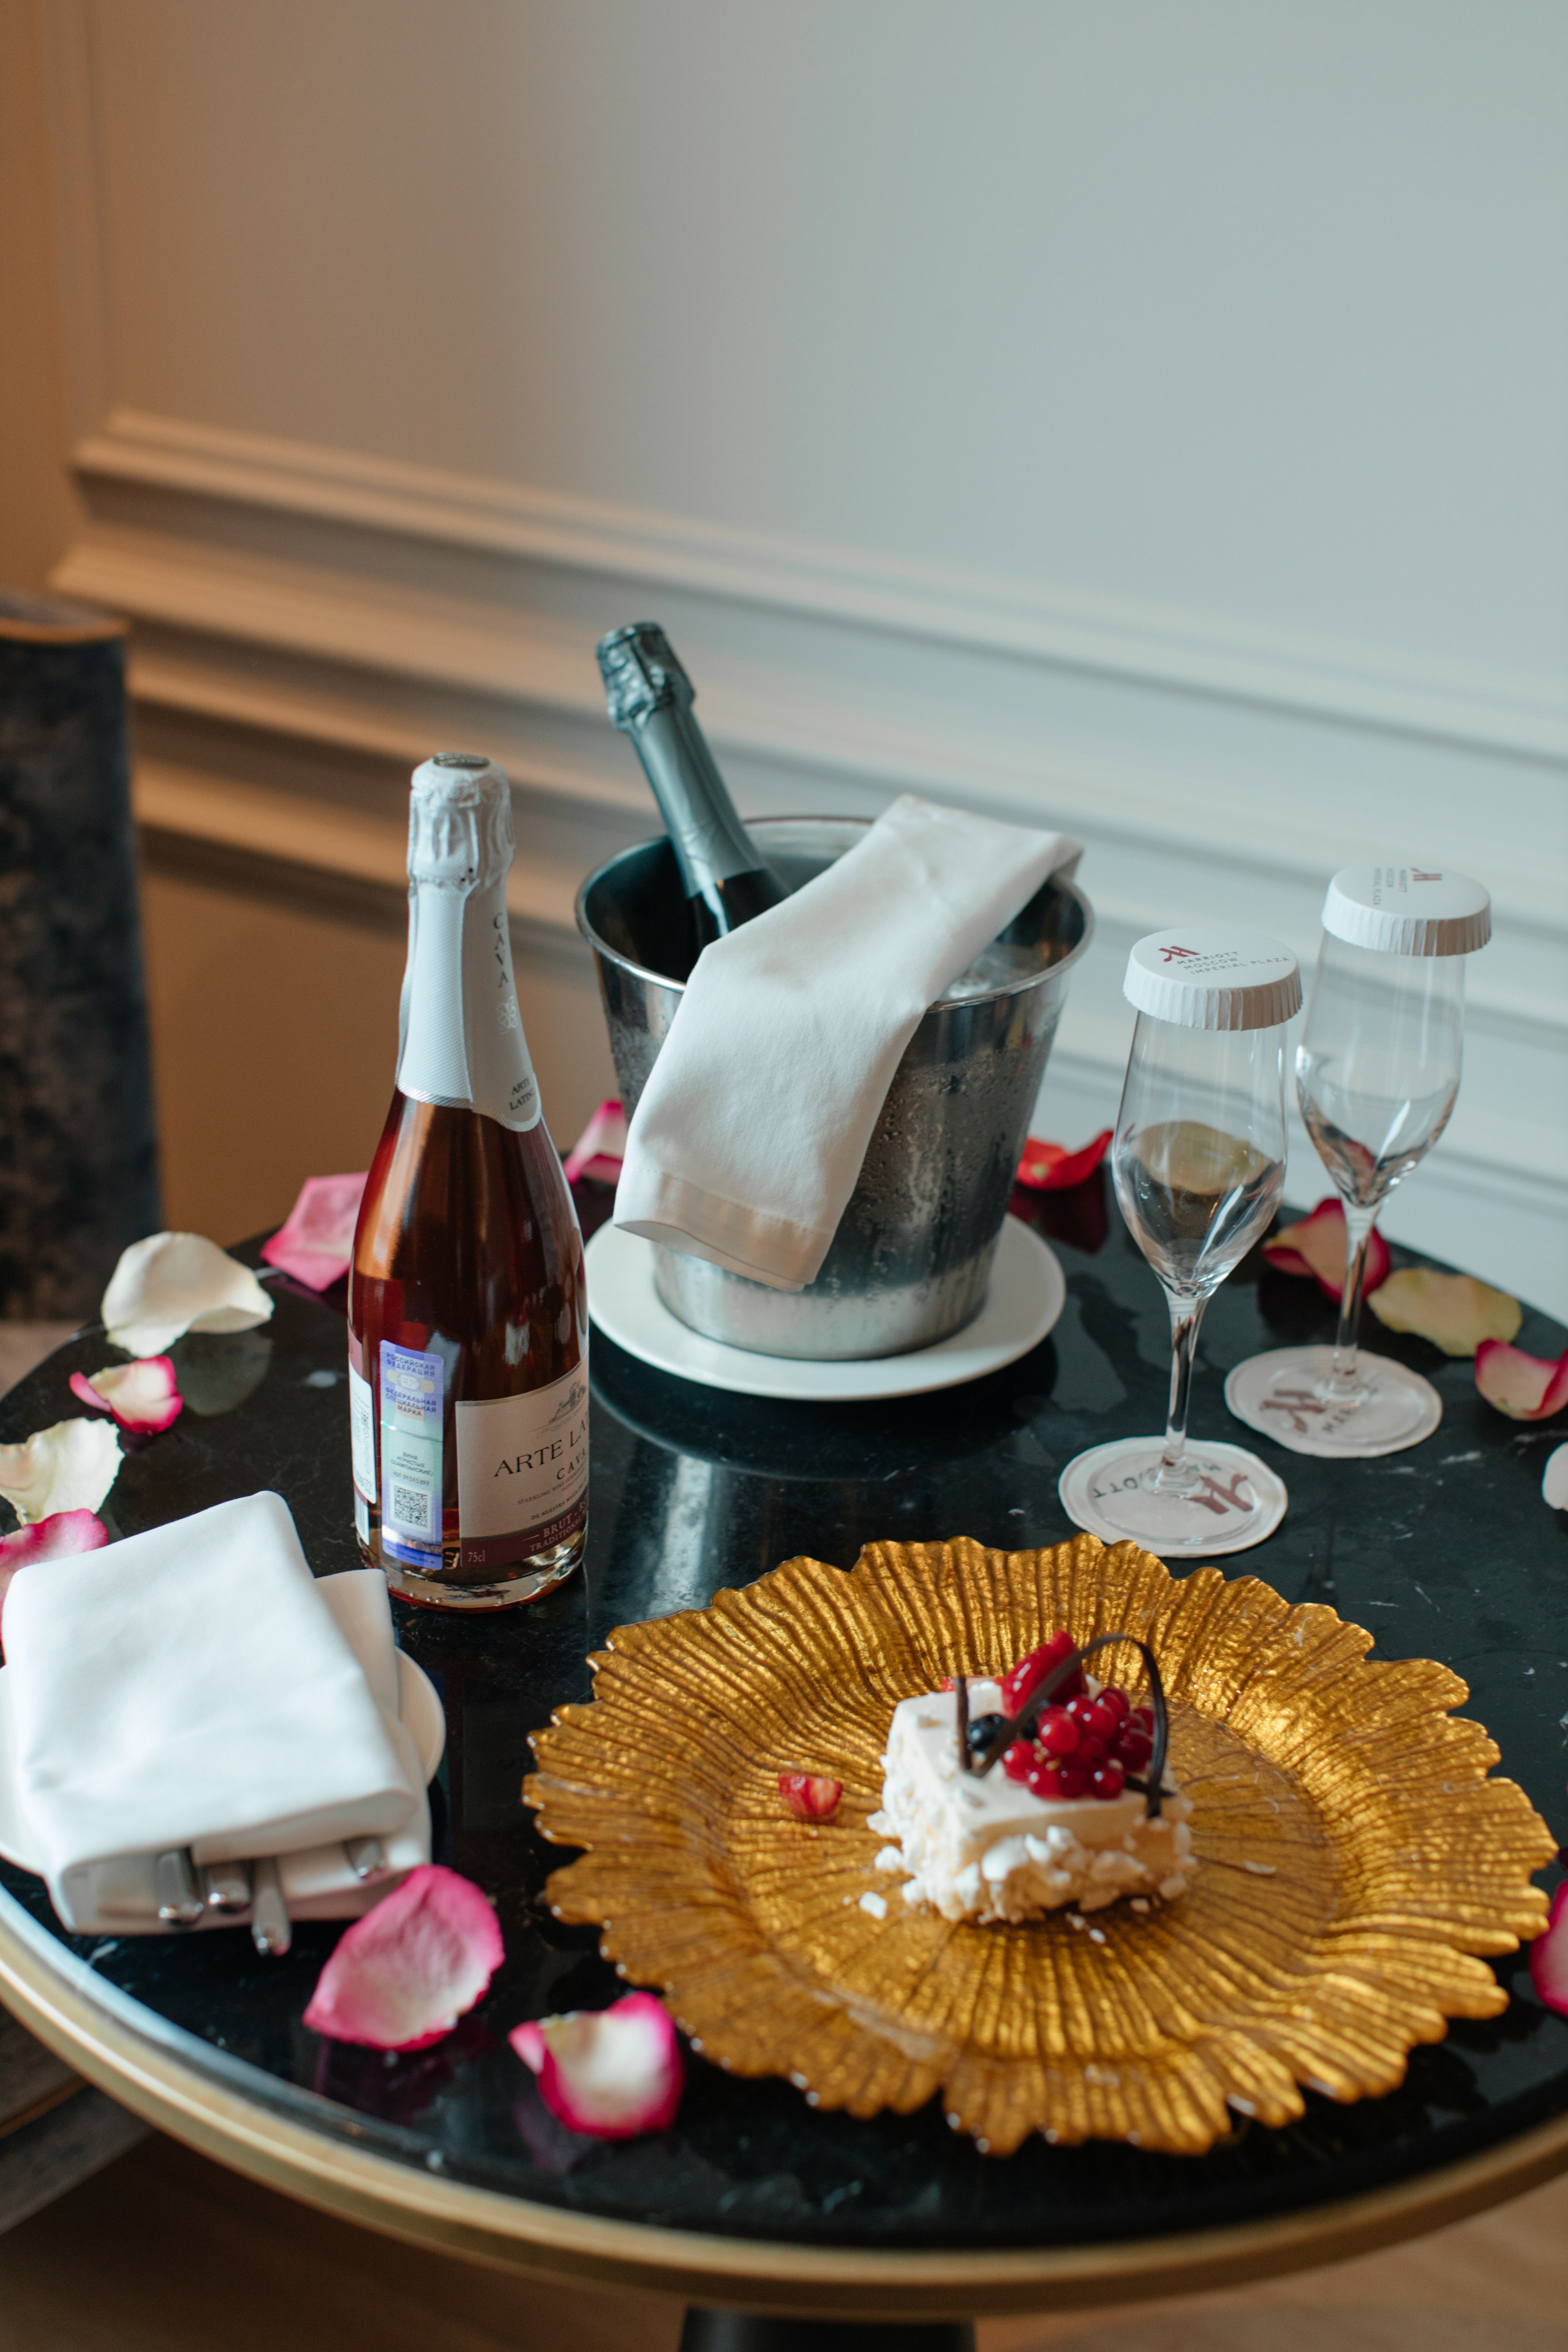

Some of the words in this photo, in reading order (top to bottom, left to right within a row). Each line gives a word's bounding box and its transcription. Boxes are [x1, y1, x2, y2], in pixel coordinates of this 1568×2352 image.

[493, 911, 509, 988] CAVA
[1176, 951, 1239, 965] MARRIOTT
[1183, 957, 1238, 970] MOSCOW
[1189, 962, 1248, 975] IMPERIAL
[1250, 957, 1291, 965] PLAZA
[386, 1352, 435, 1370] РОССИЙСКАЯ
[386, 1359, 435, 1377] ФЕДЕРАЦИЯ
[385, 1387, 437, 1406] ФЕДЕРАЛЬНАЯ
[385, 1393, 437, 1413] СПЕЦИАЛЬНАЯ
[397, 1404, 422, 1416] МАРКА
[493, 1439, 564, 1477] ARTE
[556, 1448, 586, 1480] CAVA
[543, 1513, 573, 1539] BRUT
[467, 1550, 486, 1562] 75cl
